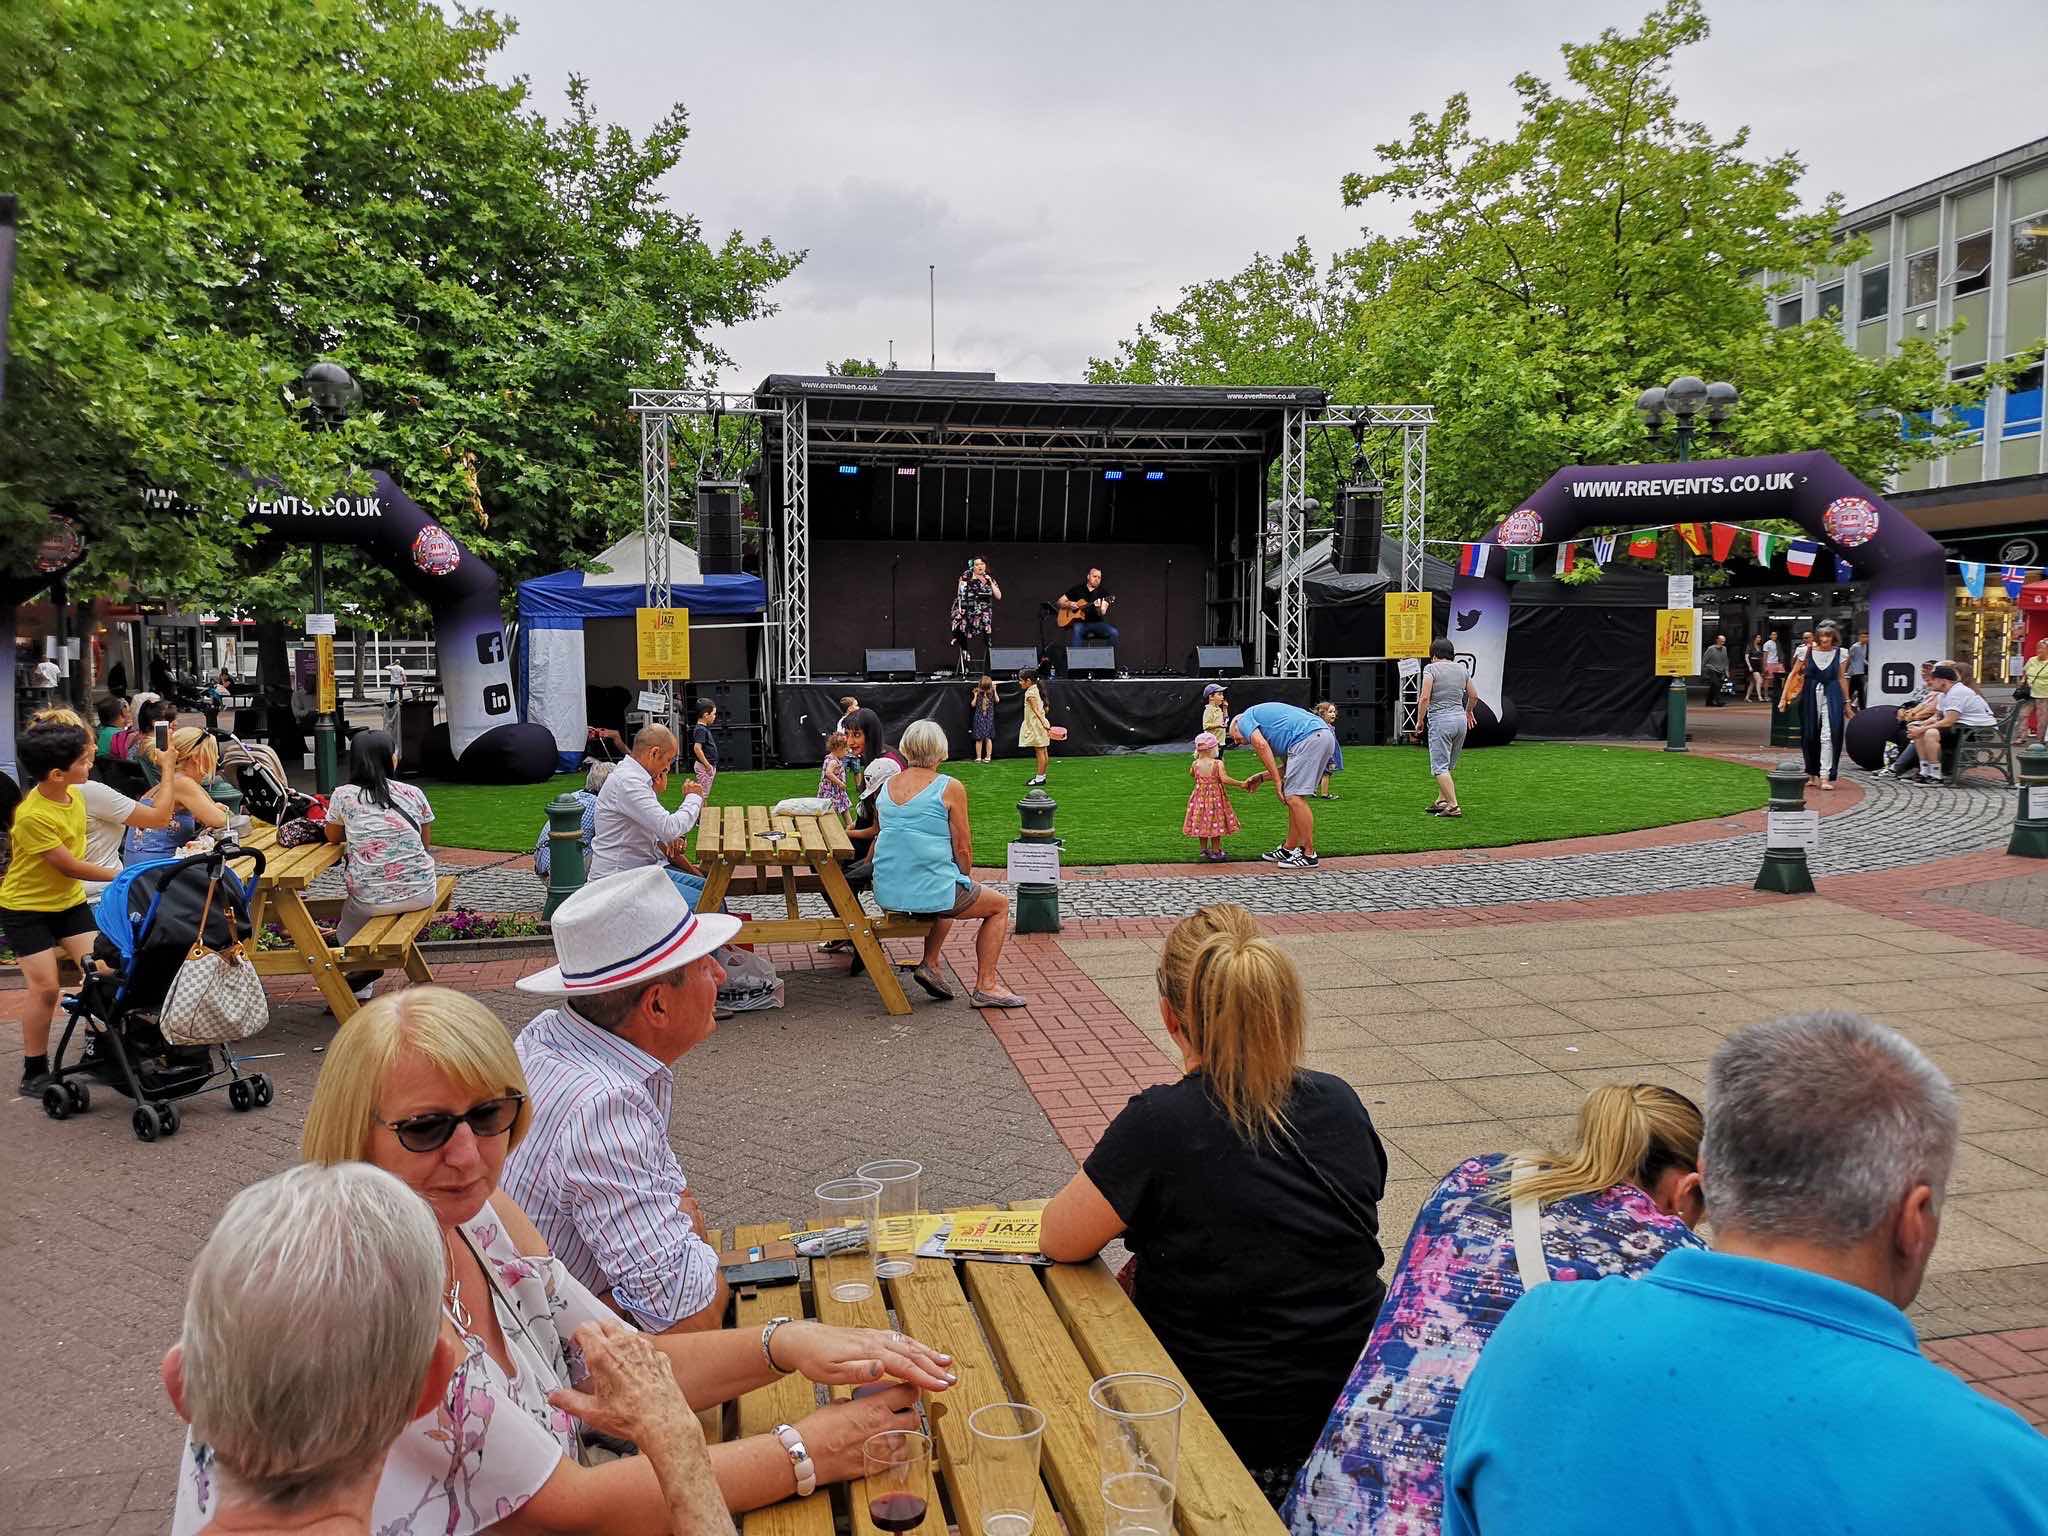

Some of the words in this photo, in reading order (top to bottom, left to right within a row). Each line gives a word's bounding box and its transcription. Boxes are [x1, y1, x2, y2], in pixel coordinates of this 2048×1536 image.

[800, 382, 878, 391] www.eventmen.co.uk
[1226, 392, 1297, 400] www.eventmen.co.uk
[1572, 472, 1795, 498] WWW.RREVENTS.CO.UK
[661, 615, 675, 625] JAZZ
[1671, 630, 1689, 647] JAZZ
[1887, 669, 1908, 687] in
[491, 691, 507, 709] in
[989, 1223, 1039, 1233] JAZZ
